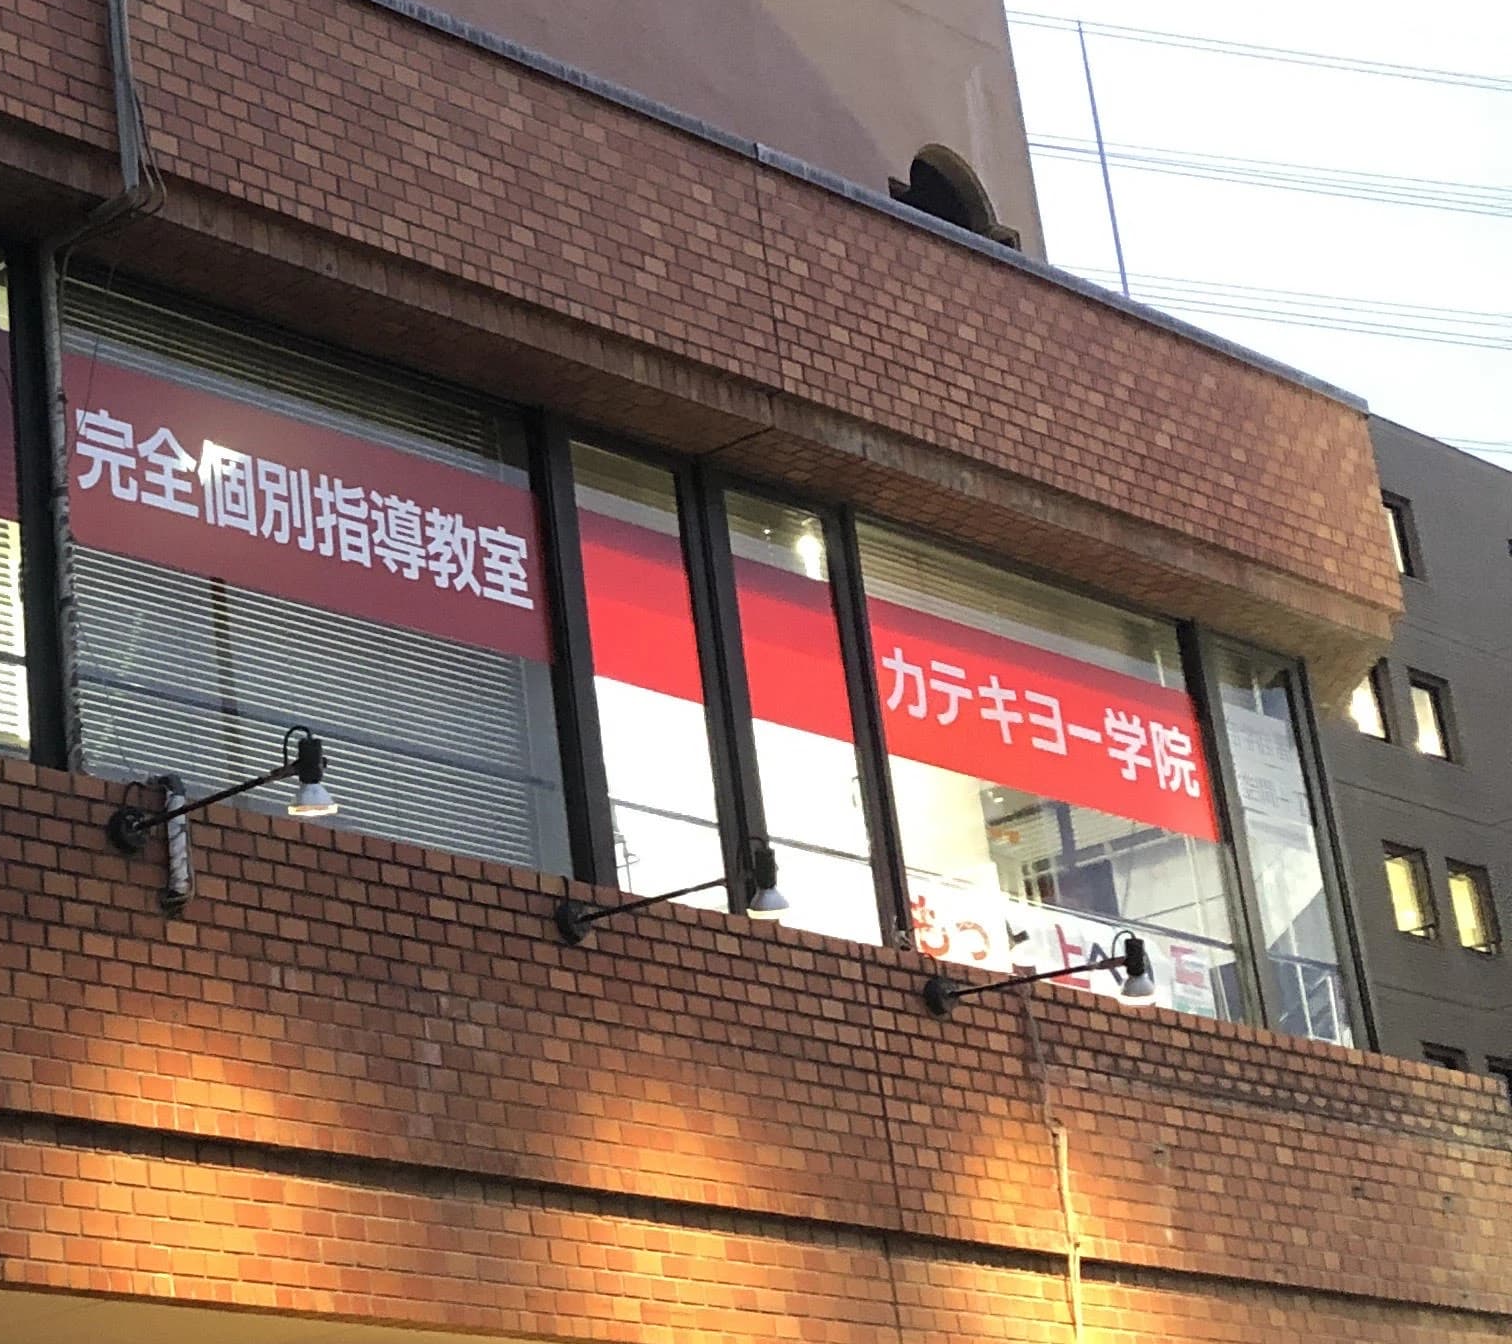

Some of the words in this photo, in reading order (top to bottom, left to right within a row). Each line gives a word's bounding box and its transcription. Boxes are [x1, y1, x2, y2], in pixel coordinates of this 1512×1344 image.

[75, 408, 535, 610] 完全個別指導教室
